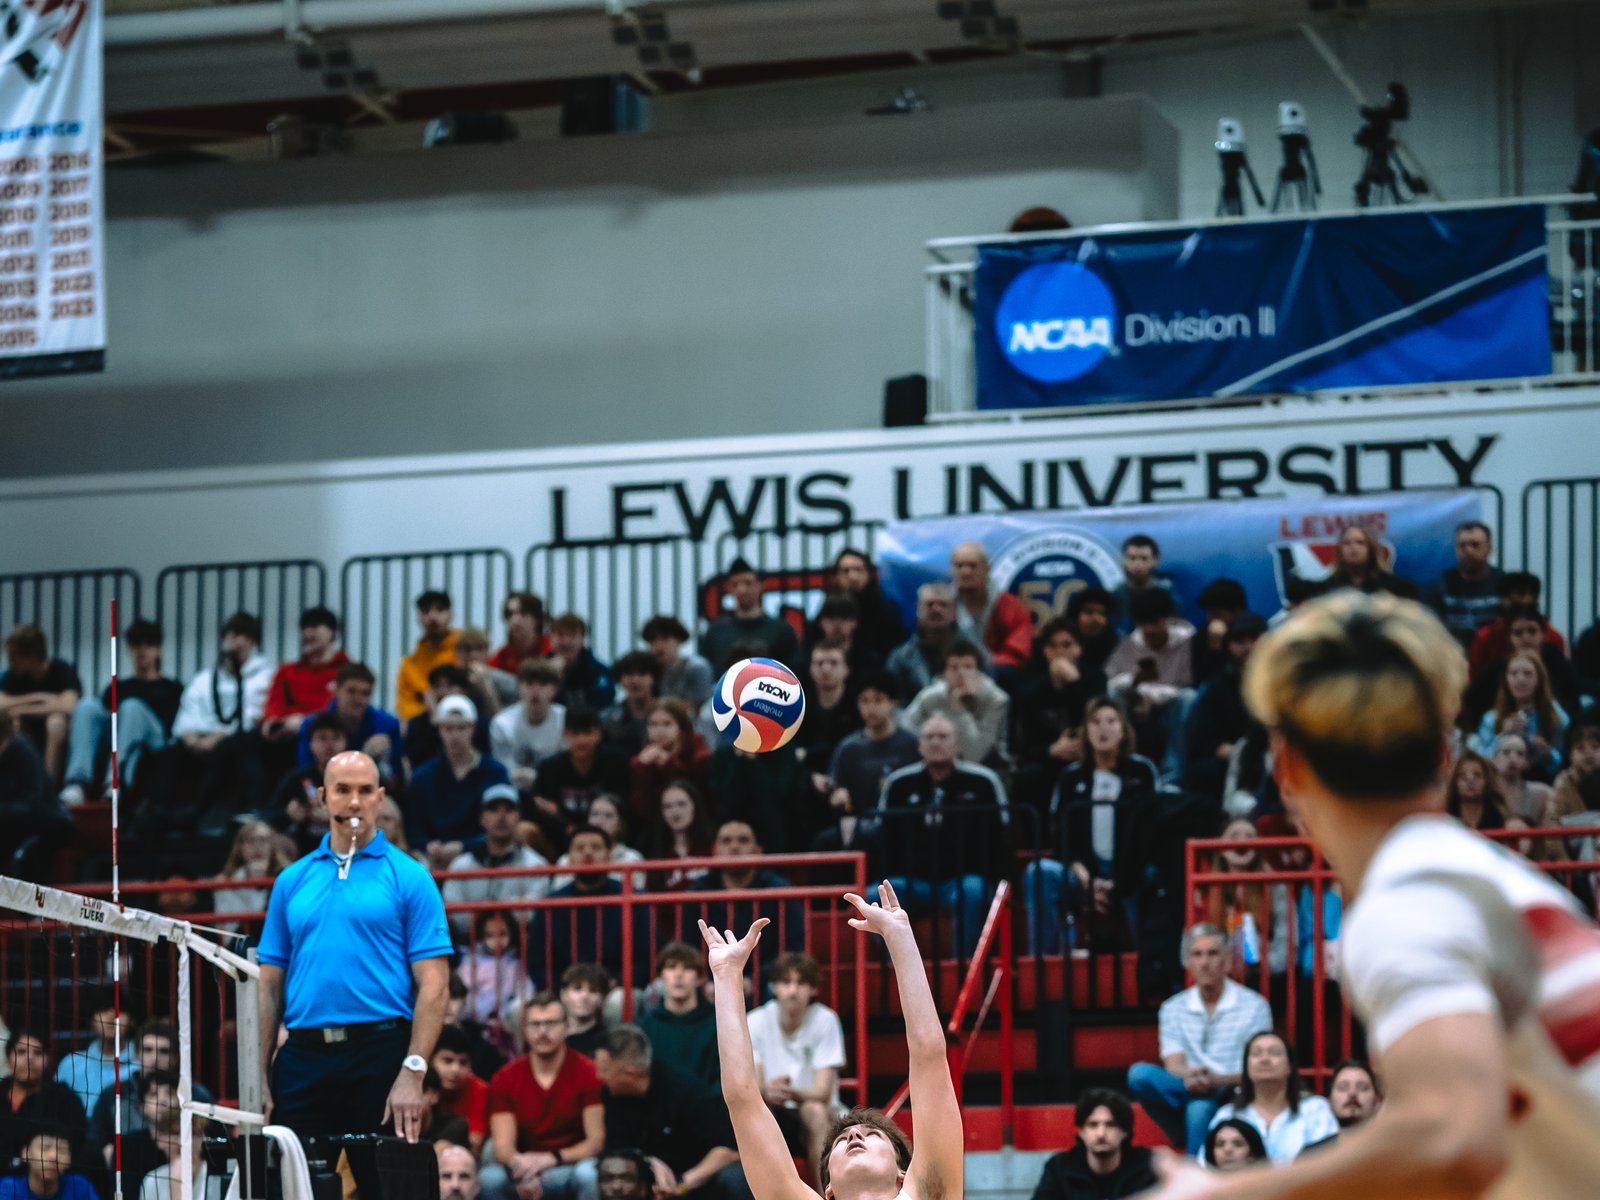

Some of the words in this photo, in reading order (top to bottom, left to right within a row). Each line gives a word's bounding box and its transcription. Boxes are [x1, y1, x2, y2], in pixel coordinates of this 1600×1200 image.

[1009, 317, 1110, 353] NCAA
[1125, 308, 1250, 347] Division
[1258, 305, 1276, 337] II
[551, 472, 853, 543] LEWIS
[893, 434, 1499, 520] UNIVERSITY
[758, 681, 790, 702] NCAA
